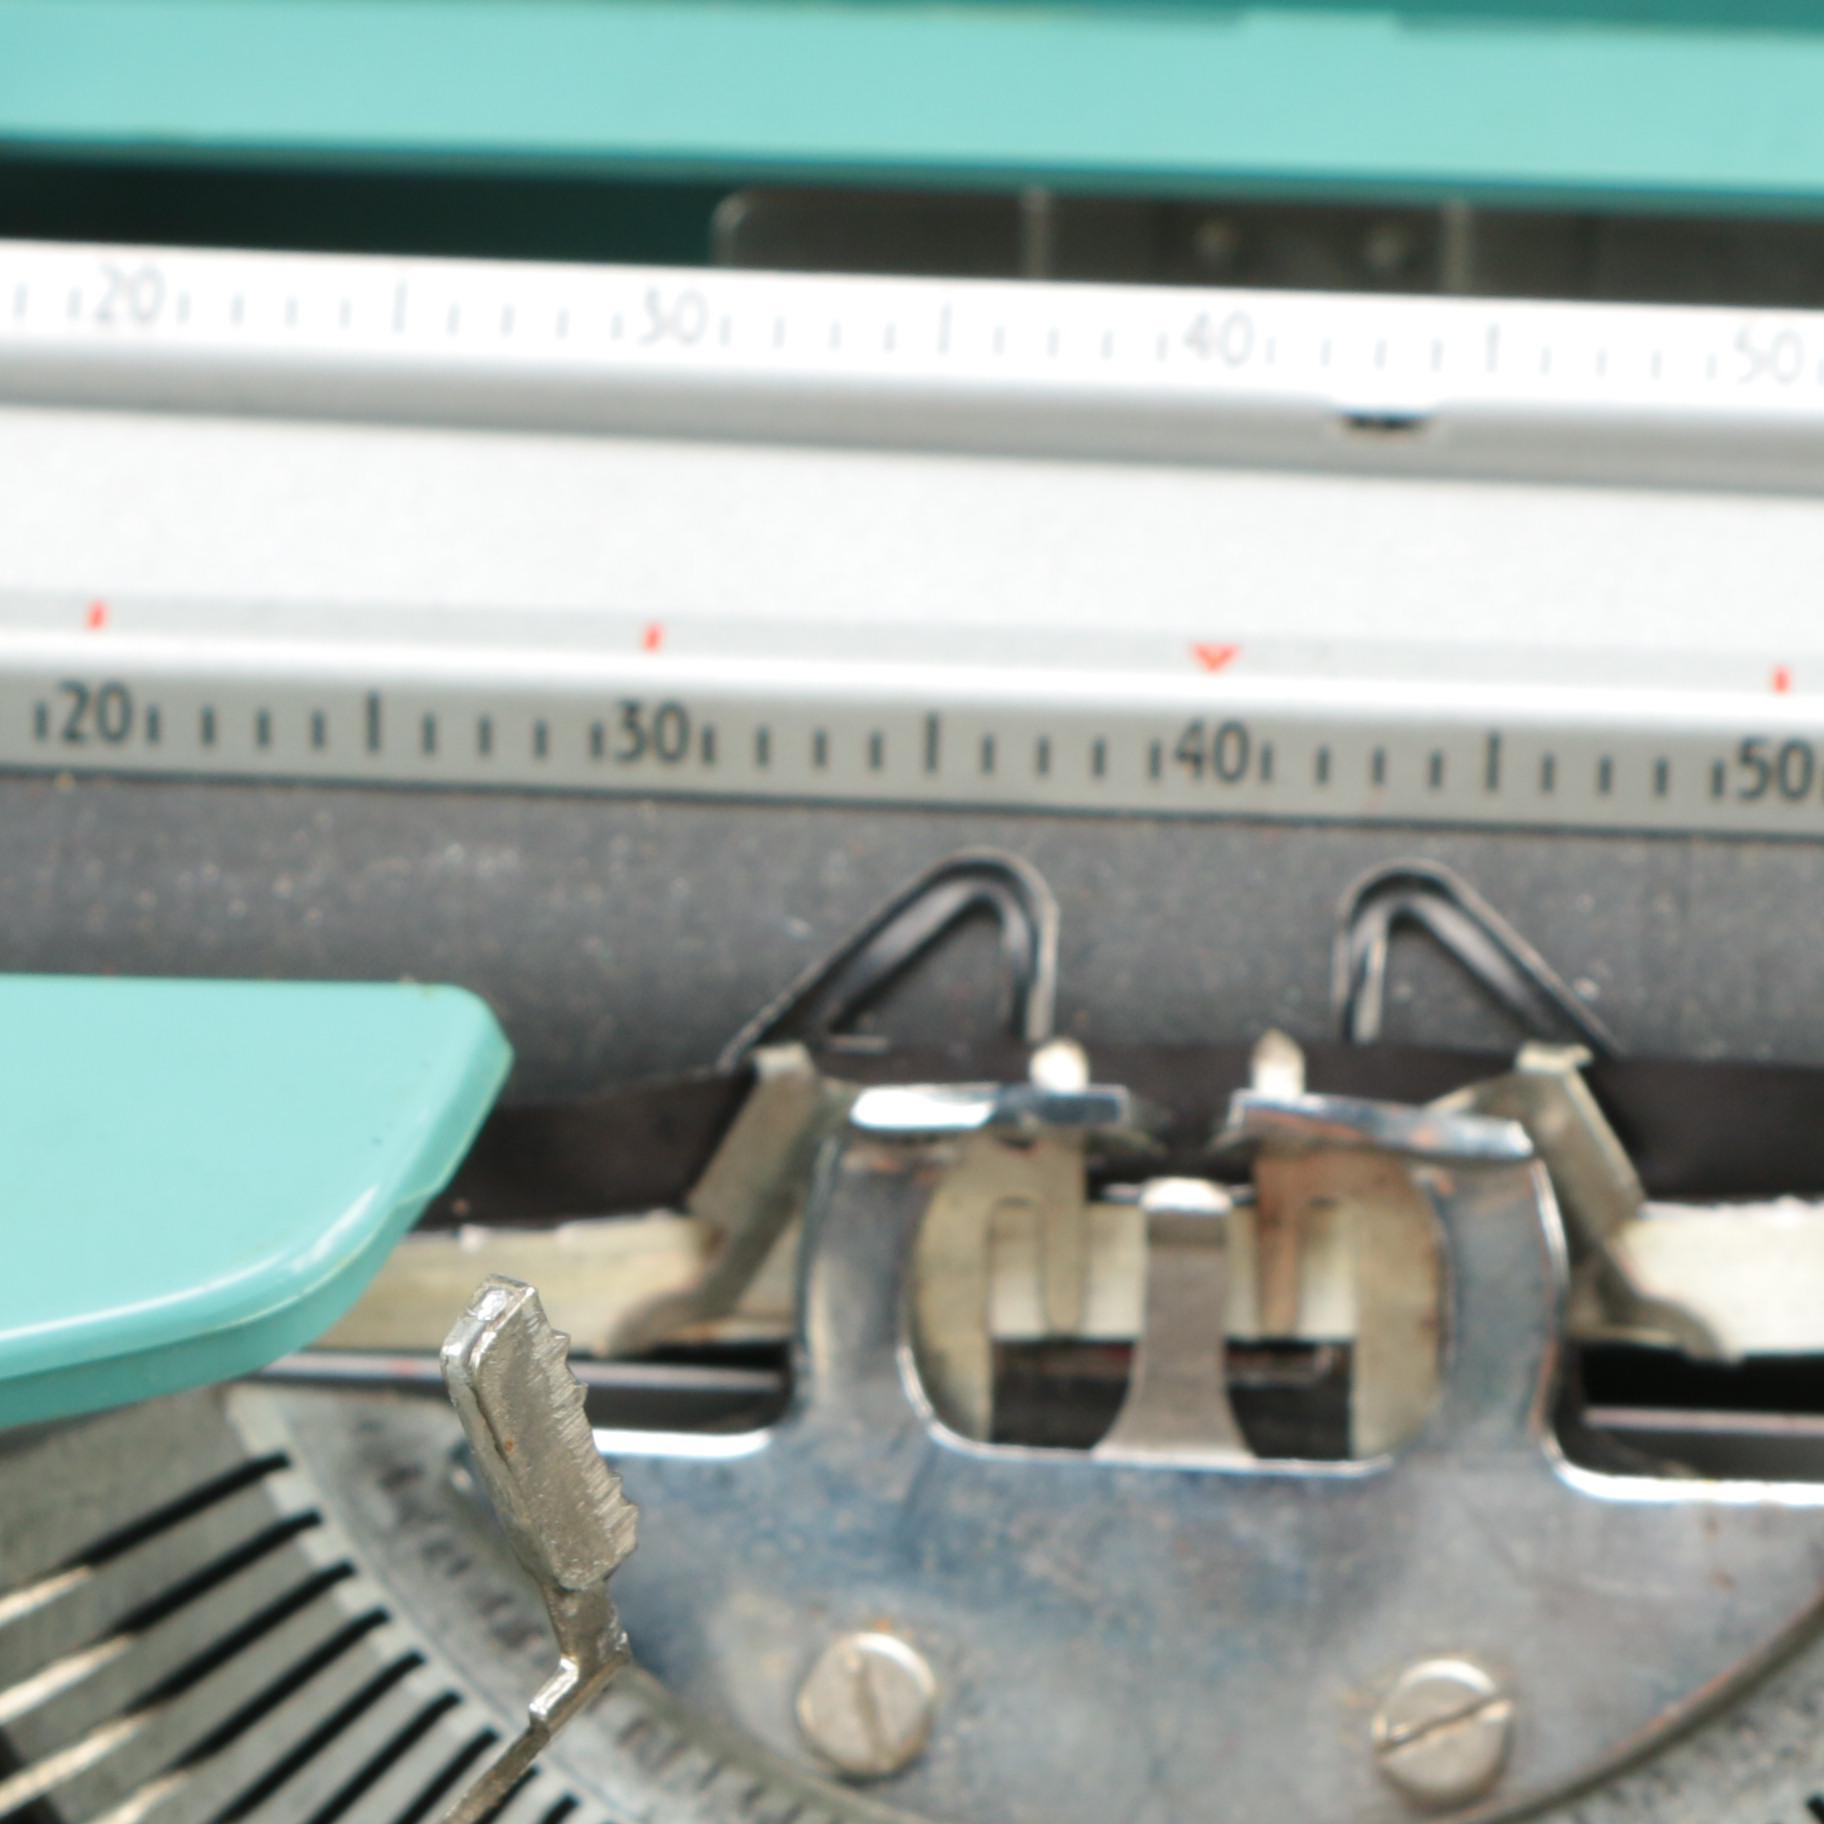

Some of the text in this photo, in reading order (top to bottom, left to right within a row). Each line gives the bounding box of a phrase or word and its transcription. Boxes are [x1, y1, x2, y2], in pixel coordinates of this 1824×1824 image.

[93, 261, 165, 325] 20
[1183, 309, 1255, 368] 40
[1735, 322, 1805, 385] 50
[60, 682, 133, 745] 20
[614, 702, 692, 765] 30
[1174, 721, 1251, 784] 40
[1737, 740, 1816, 803] 50
